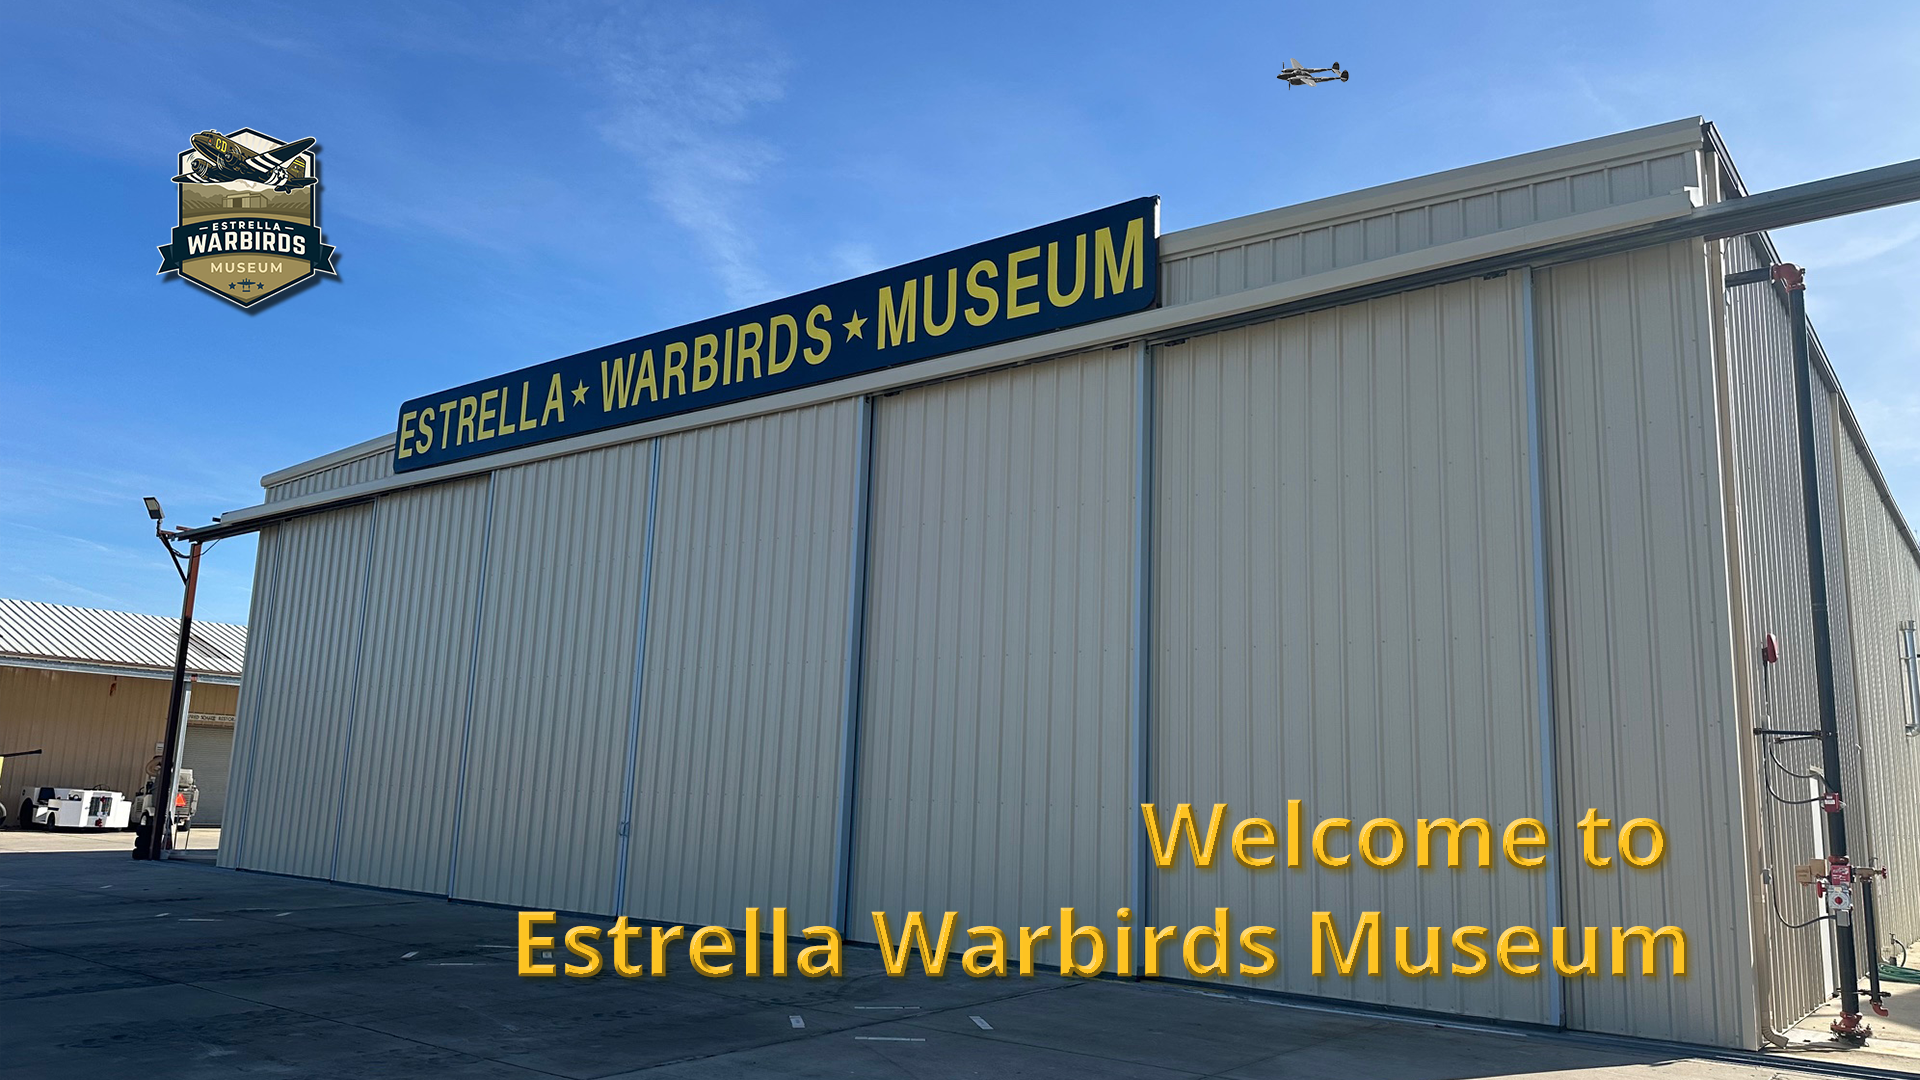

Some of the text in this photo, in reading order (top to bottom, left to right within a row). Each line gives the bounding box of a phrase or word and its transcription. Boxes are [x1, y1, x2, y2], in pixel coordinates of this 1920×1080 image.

[398, 217, 1144, 460] ESTRELLA WARBIRDS MUSEUM
